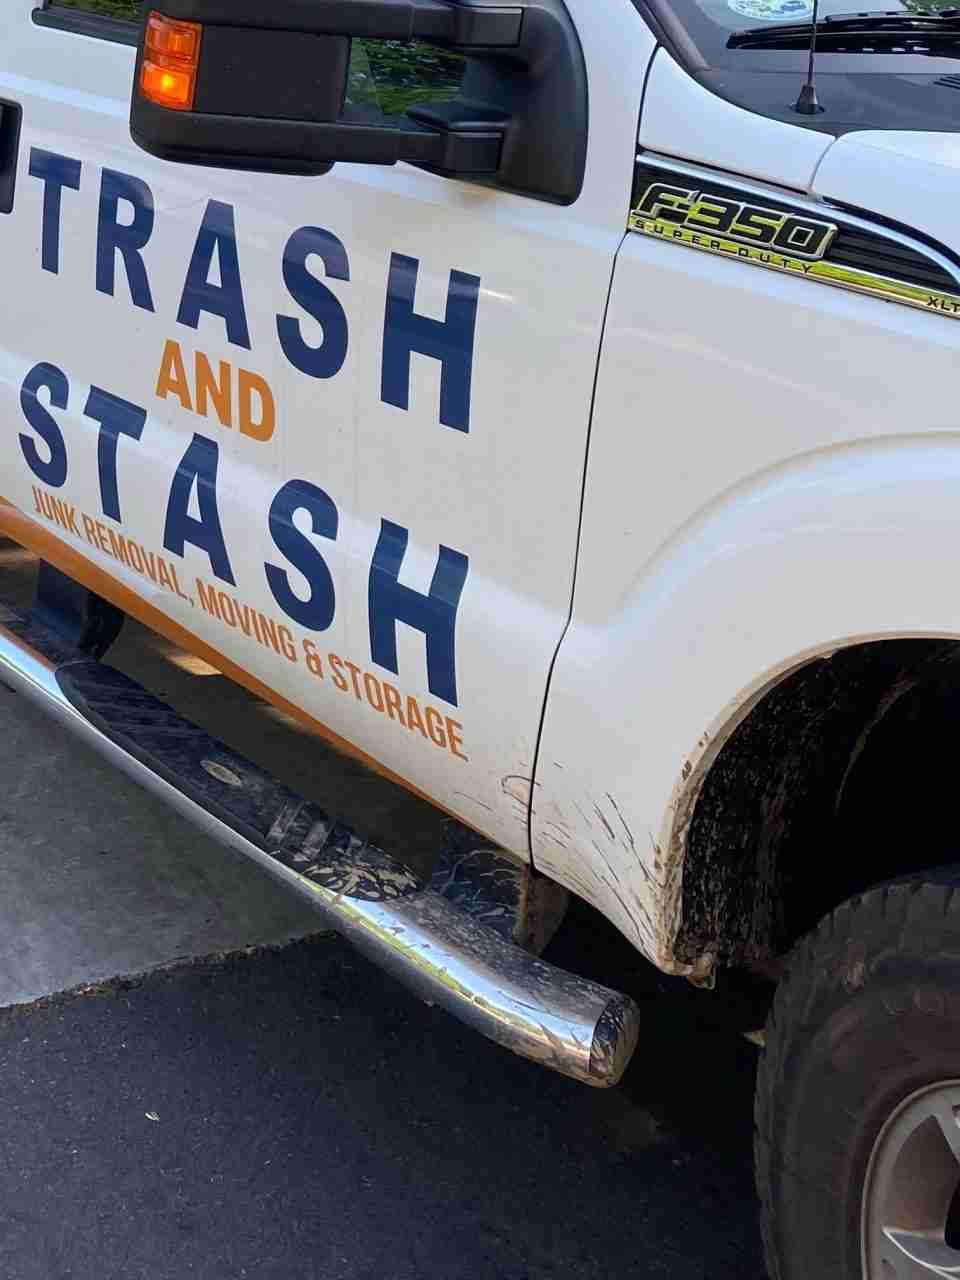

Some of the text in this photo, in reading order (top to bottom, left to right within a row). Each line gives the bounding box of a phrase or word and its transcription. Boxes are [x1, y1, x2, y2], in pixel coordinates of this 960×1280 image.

[29, 146, 481, 434] TRASH
[635, 219, 813, 274] SUPER DUTY
[927, 295, 960, 313] XLT
[155, 338, 276, 442] AND
[18, 361, 469, 707] STASH
[32, 484, 469, 762] JUNK REMOVAL, MOVING & STORAGE
